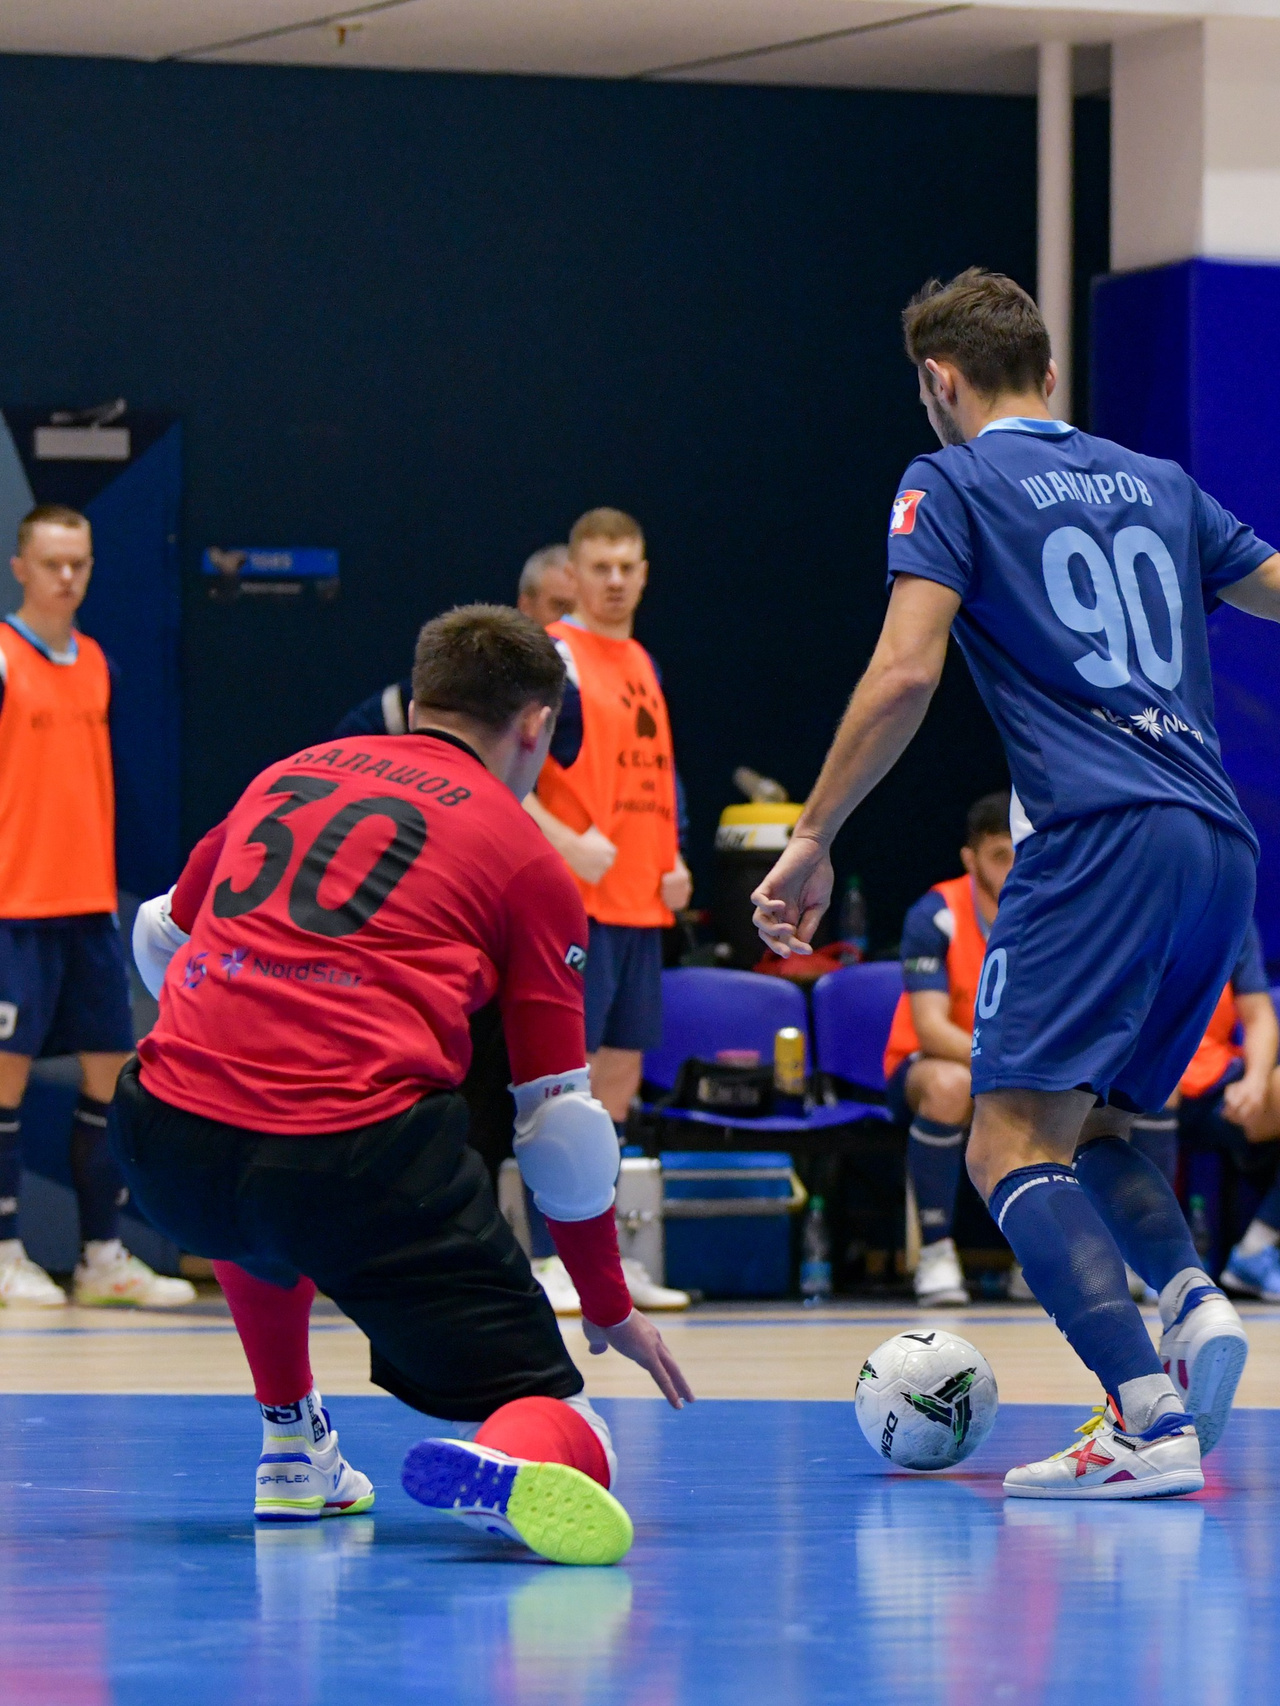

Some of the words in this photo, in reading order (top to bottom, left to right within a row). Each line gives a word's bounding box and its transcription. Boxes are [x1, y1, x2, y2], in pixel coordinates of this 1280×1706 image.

[1020, 470, 1153, 510] ШАКИРОВ
[1042, 525, 1183, 691] 90
[213, 775, 427, 937] 30
[251, 957, 362, 989] NordStar
